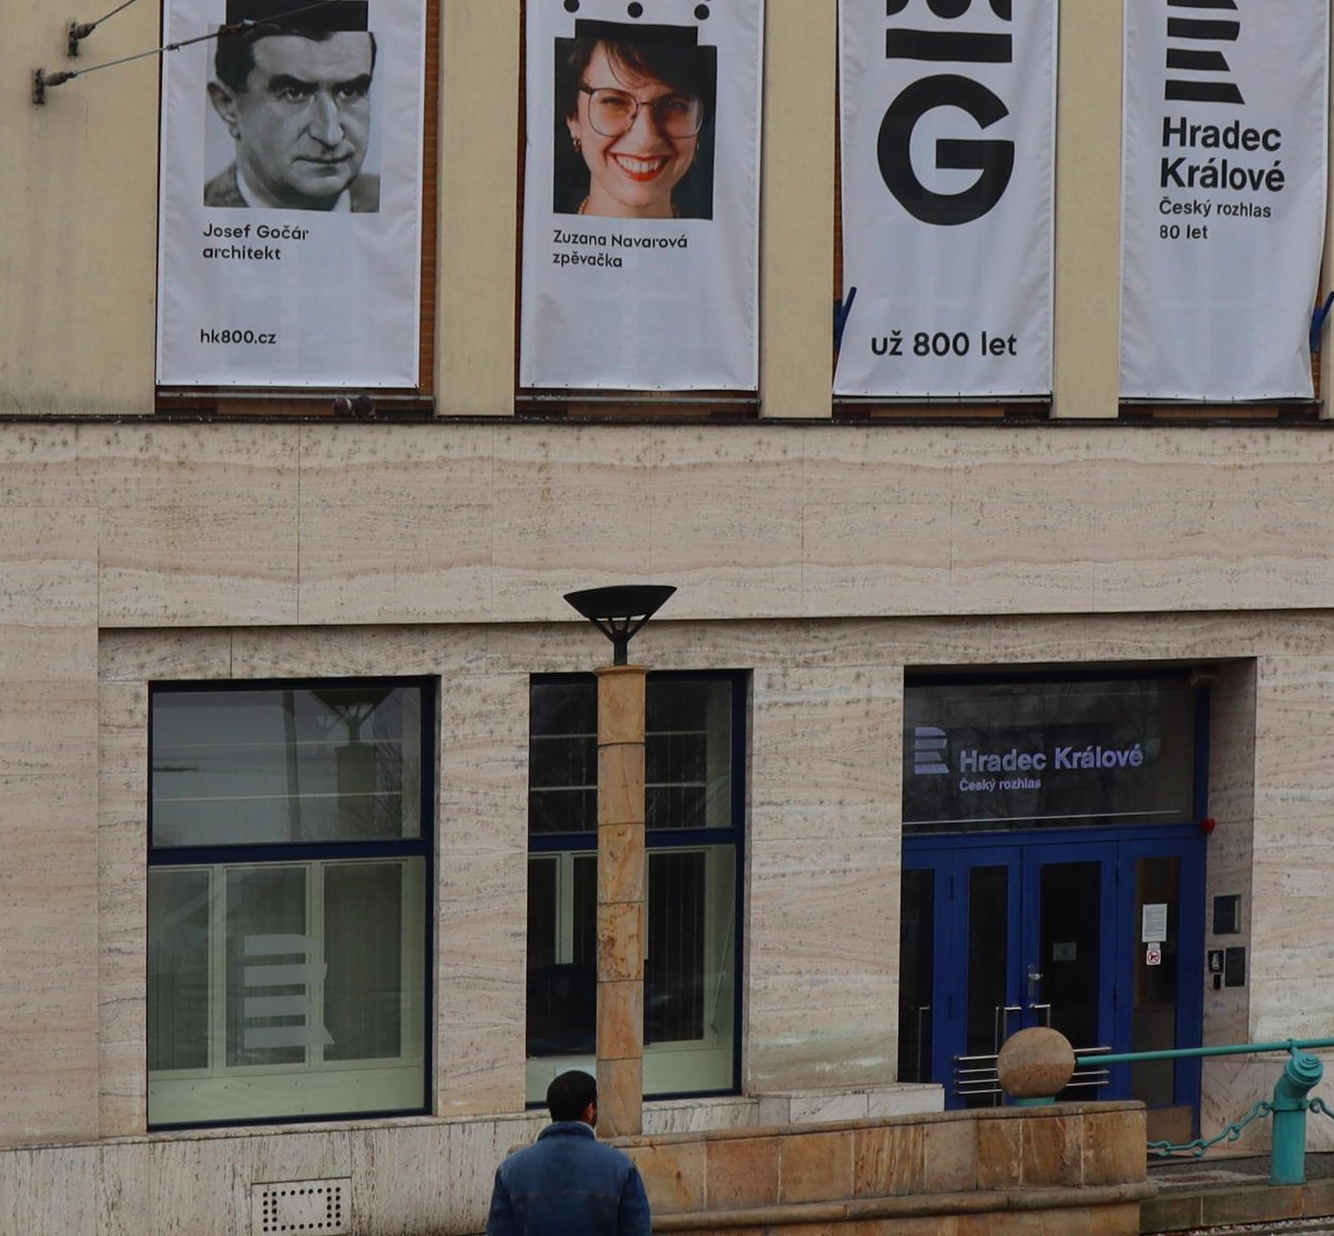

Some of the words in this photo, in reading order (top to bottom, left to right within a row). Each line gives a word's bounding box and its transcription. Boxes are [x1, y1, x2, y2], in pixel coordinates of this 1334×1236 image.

[1161, 116, 1282, 152] Hradec
[1160, 157, 1286, 193] Králové
[1159, 196, 1212, 218] Český
[1216, 201, 1272, 218] rozhlas
[202, 223, 251, 239] Josef
[256, 224, 309, 240] Gočár
[553, 229, 607, 247] Zuzana
[611, 233, 688, 249] Navarová
[1159, 224, 1181, 240] 80
[1186, 224, 1208, 240] let
[202, 244, 281, 261] architekt
[553, 250, 623, 269] zpěvačka
[200, 328, 276, 346] hk800.cz
[871, 329, 903, 356] už
[913, 331, 970, 357] 800
[981, 331, 1017, 356] let
[959, 748, 1047, 773] Hradec
[1054, 743, 1144, 770] Králové
[959, 777, 996, 792] Český
[999, 777, 1042, 790] rozhlas
